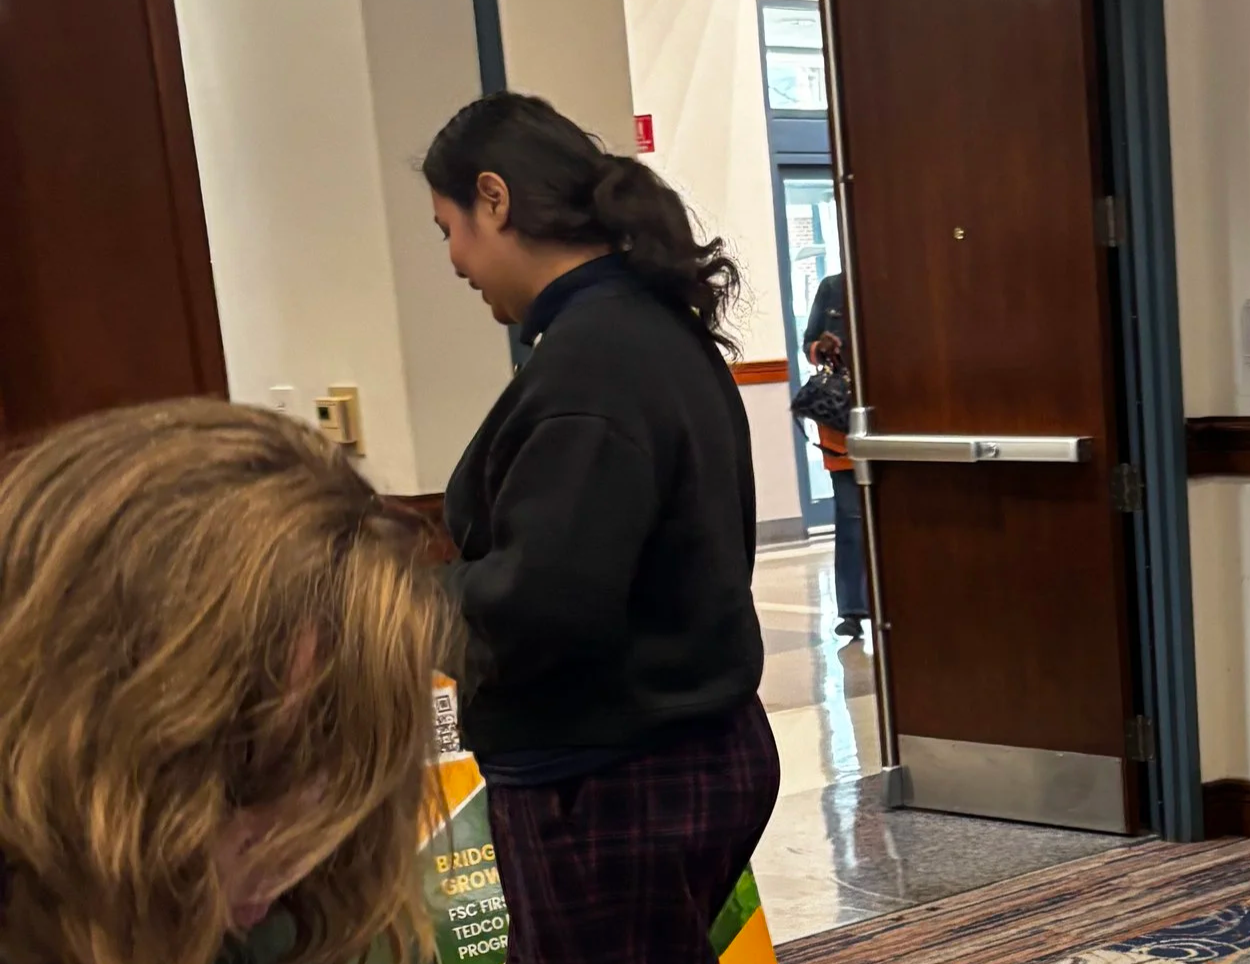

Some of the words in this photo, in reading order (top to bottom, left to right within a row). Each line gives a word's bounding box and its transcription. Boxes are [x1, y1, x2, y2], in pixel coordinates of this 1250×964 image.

[437, 844, 496, 873] BRIDG
[441, 867, 500, 895] GROW
[449, 903, 478, 921] FSC
[480, 895, 507, 913] FIRS
[453, 917, 504, 940] TEDCO
[458, 935, 508, 959] PROGR
